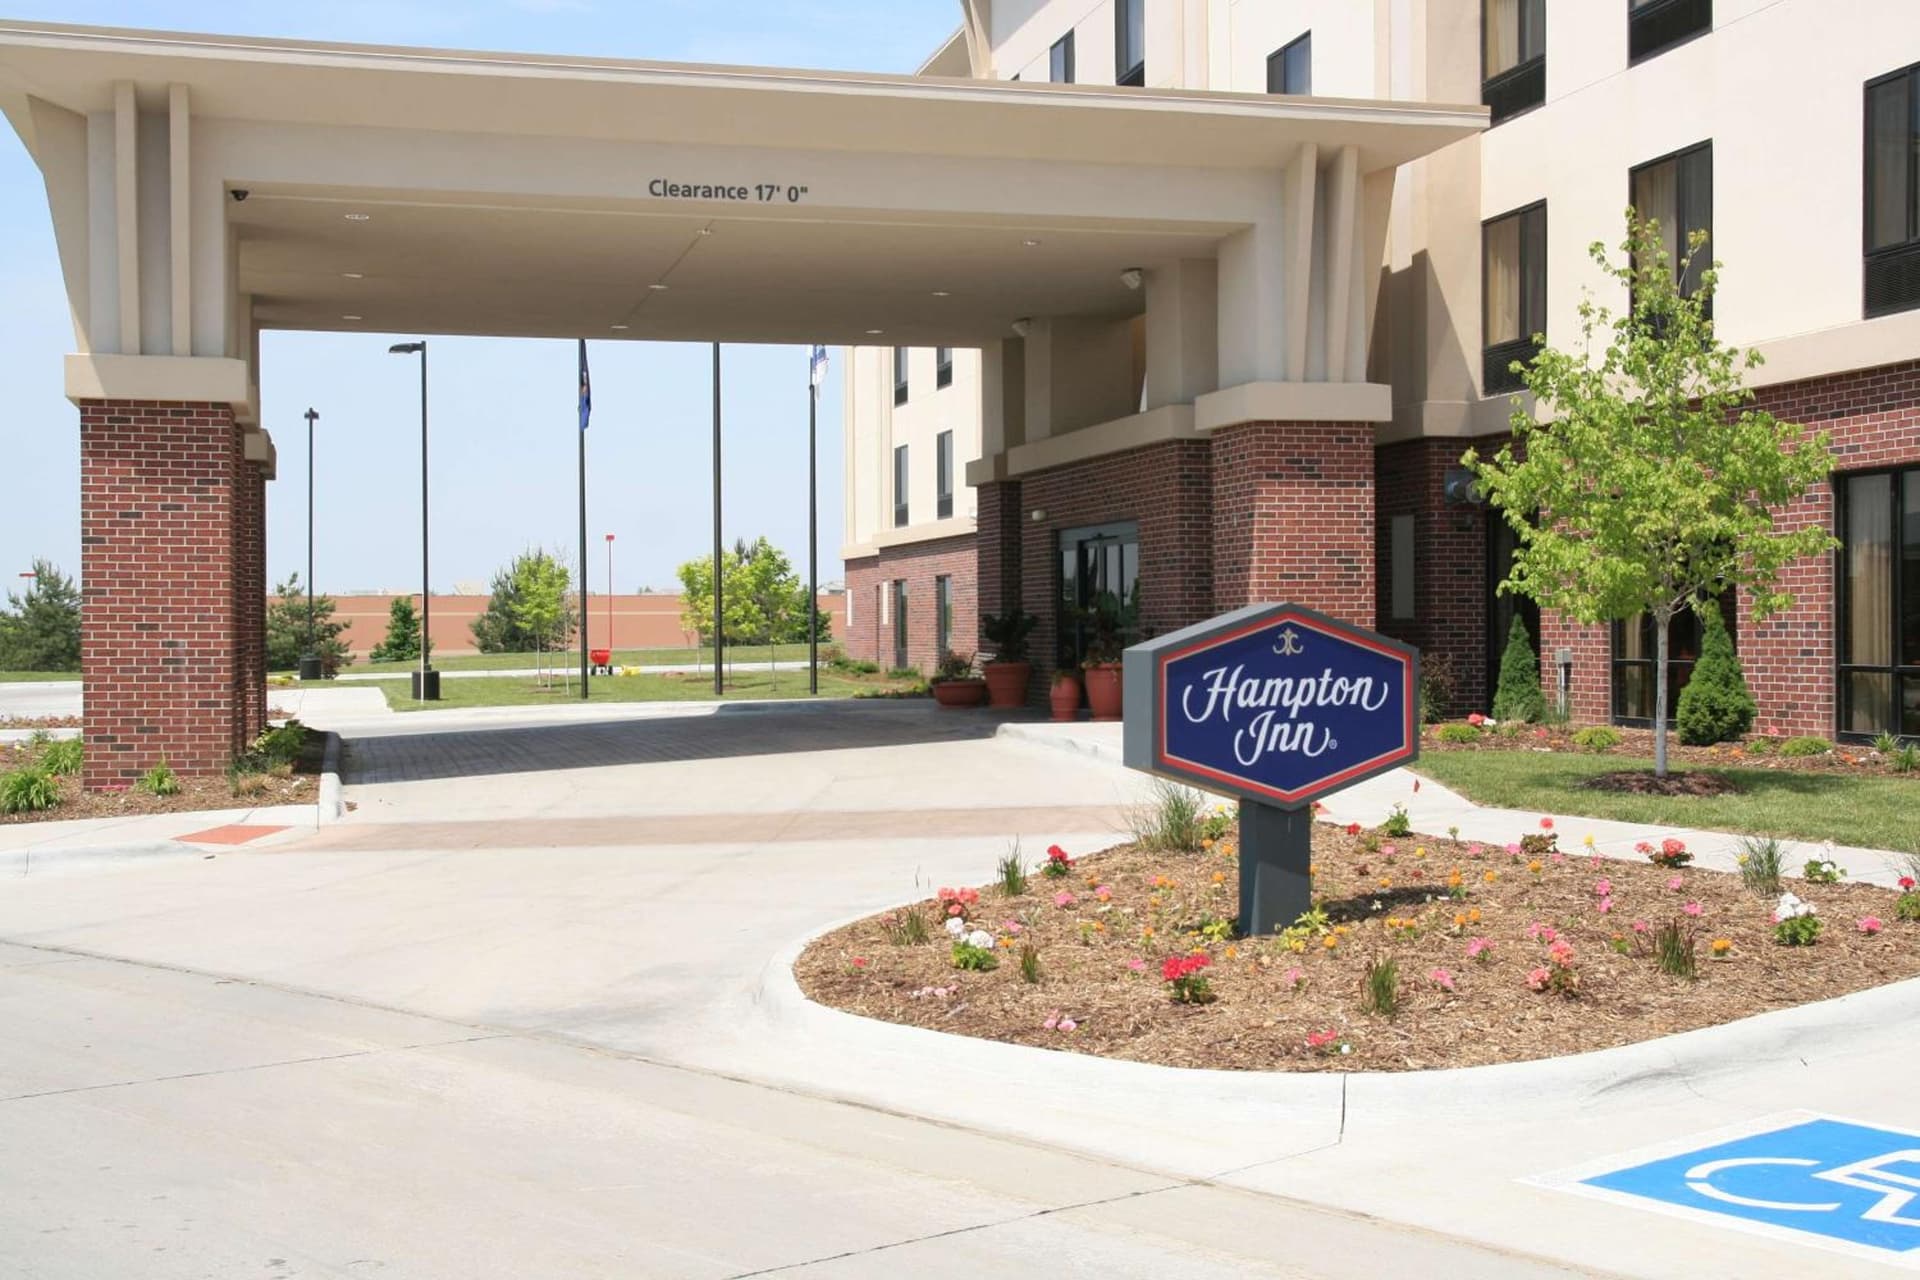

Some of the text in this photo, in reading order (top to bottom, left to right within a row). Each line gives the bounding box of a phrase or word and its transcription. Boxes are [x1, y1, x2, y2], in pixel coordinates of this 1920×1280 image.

[649, 179, 808, 203] Clearance 17' 0"
[1182, 664, 1388, 723] Hampton
